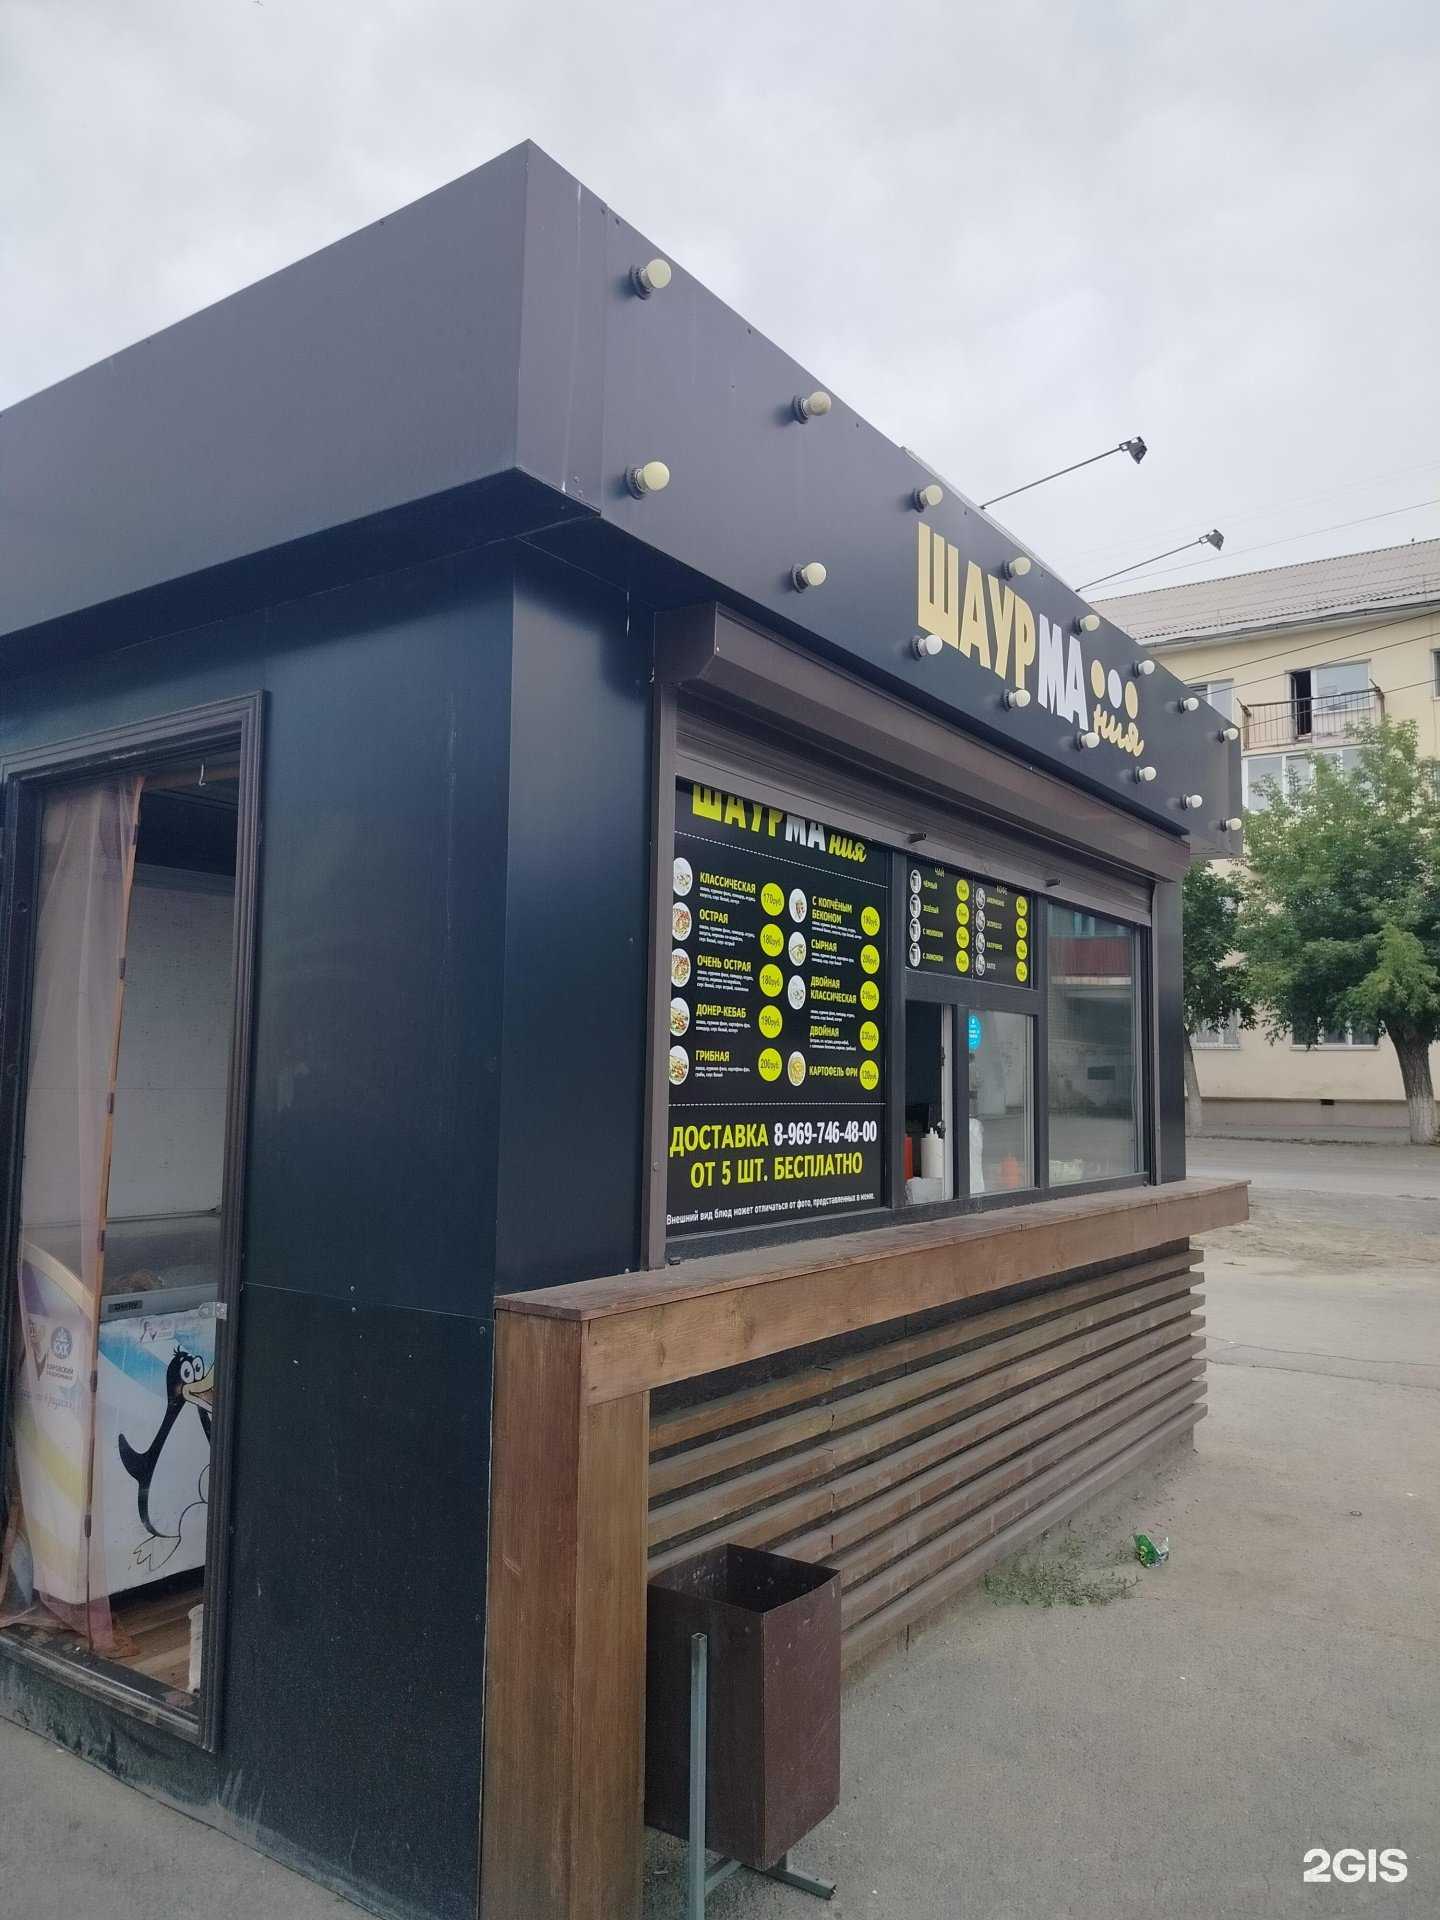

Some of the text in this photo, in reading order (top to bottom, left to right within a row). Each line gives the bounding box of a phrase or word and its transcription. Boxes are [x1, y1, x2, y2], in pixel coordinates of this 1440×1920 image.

[700, 872, 756, 894] КЛАССИЧЕСКАЯ
[699, 909, 729, 924] ОСТРАЯ
[811, 939, 838, 952] СЫРНАЯ
[697, 955, 752, 972] ОЧЕНЬ ОСТРАЯ
[810, 989, 857, 1004] КЛАССИЧЕСКАЯ
[695, 1003, 747, 1018] ДОНЕР-КЕБАБ
[695, 1050, 730, 1062] ГРИБНАЯ
[809, 1065, 845, 1077] КАРТОФЕЛЬ
[669, 1120, 877, 1158] ДОСТАВКА 8-969-746-48-00
[690, 1151, 863, 1189] ОТ 5 ШТ. БЕСПЛАТНО
[666, 1209, 699, 1226] Внешний
[700, 1211, 713, 1222] вид
[714, 1208, 733, 1219] блюд
[733, 1206, 754, 1217] может
[754, 1202, 789, 1214] отличаться
[789, 1201, 796, 1209] от
